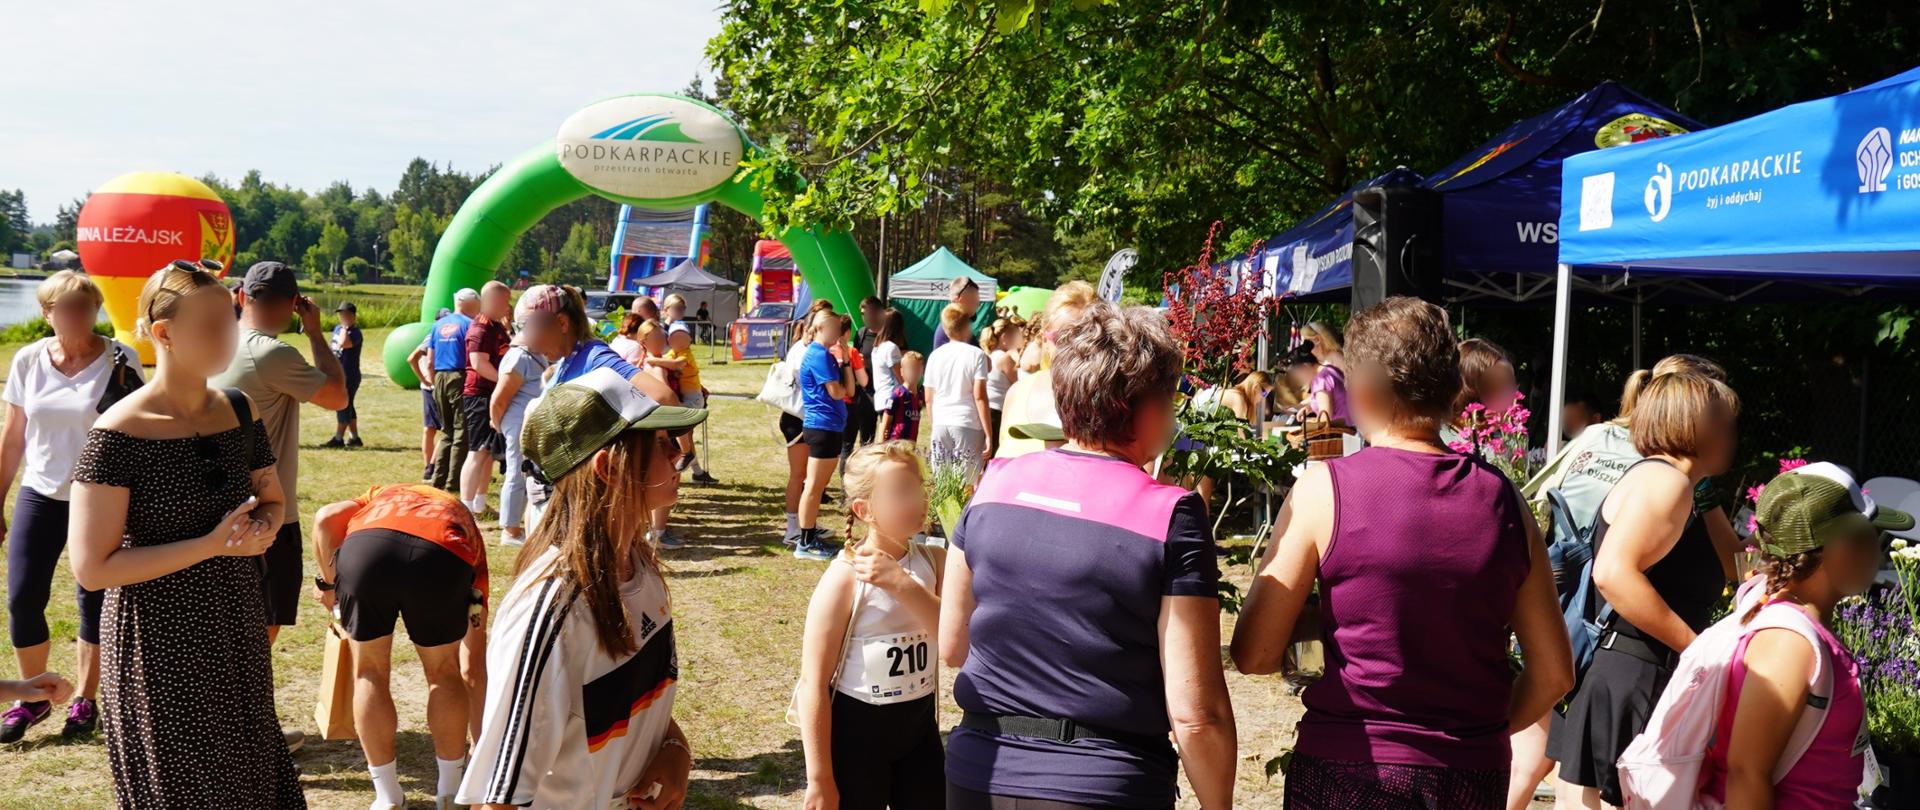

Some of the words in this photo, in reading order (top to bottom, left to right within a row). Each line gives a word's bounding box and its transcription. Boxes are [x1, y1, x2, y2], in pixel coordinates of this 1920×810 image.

[563, 144, 732, 167] PODKARPACKIE
[594, 164, 650, 174] przestrzeń
[655, 167, 698, 176] otwarta
[1679, 151, 1802, 191] PODKARPACKIE
[1706, 195, 1718, 208] żyj
[1725, 189, 1762, 205] oddychaj
[104, 225, 183, 245] LEŻAJSK
[887, 641, 927, 677] 210
